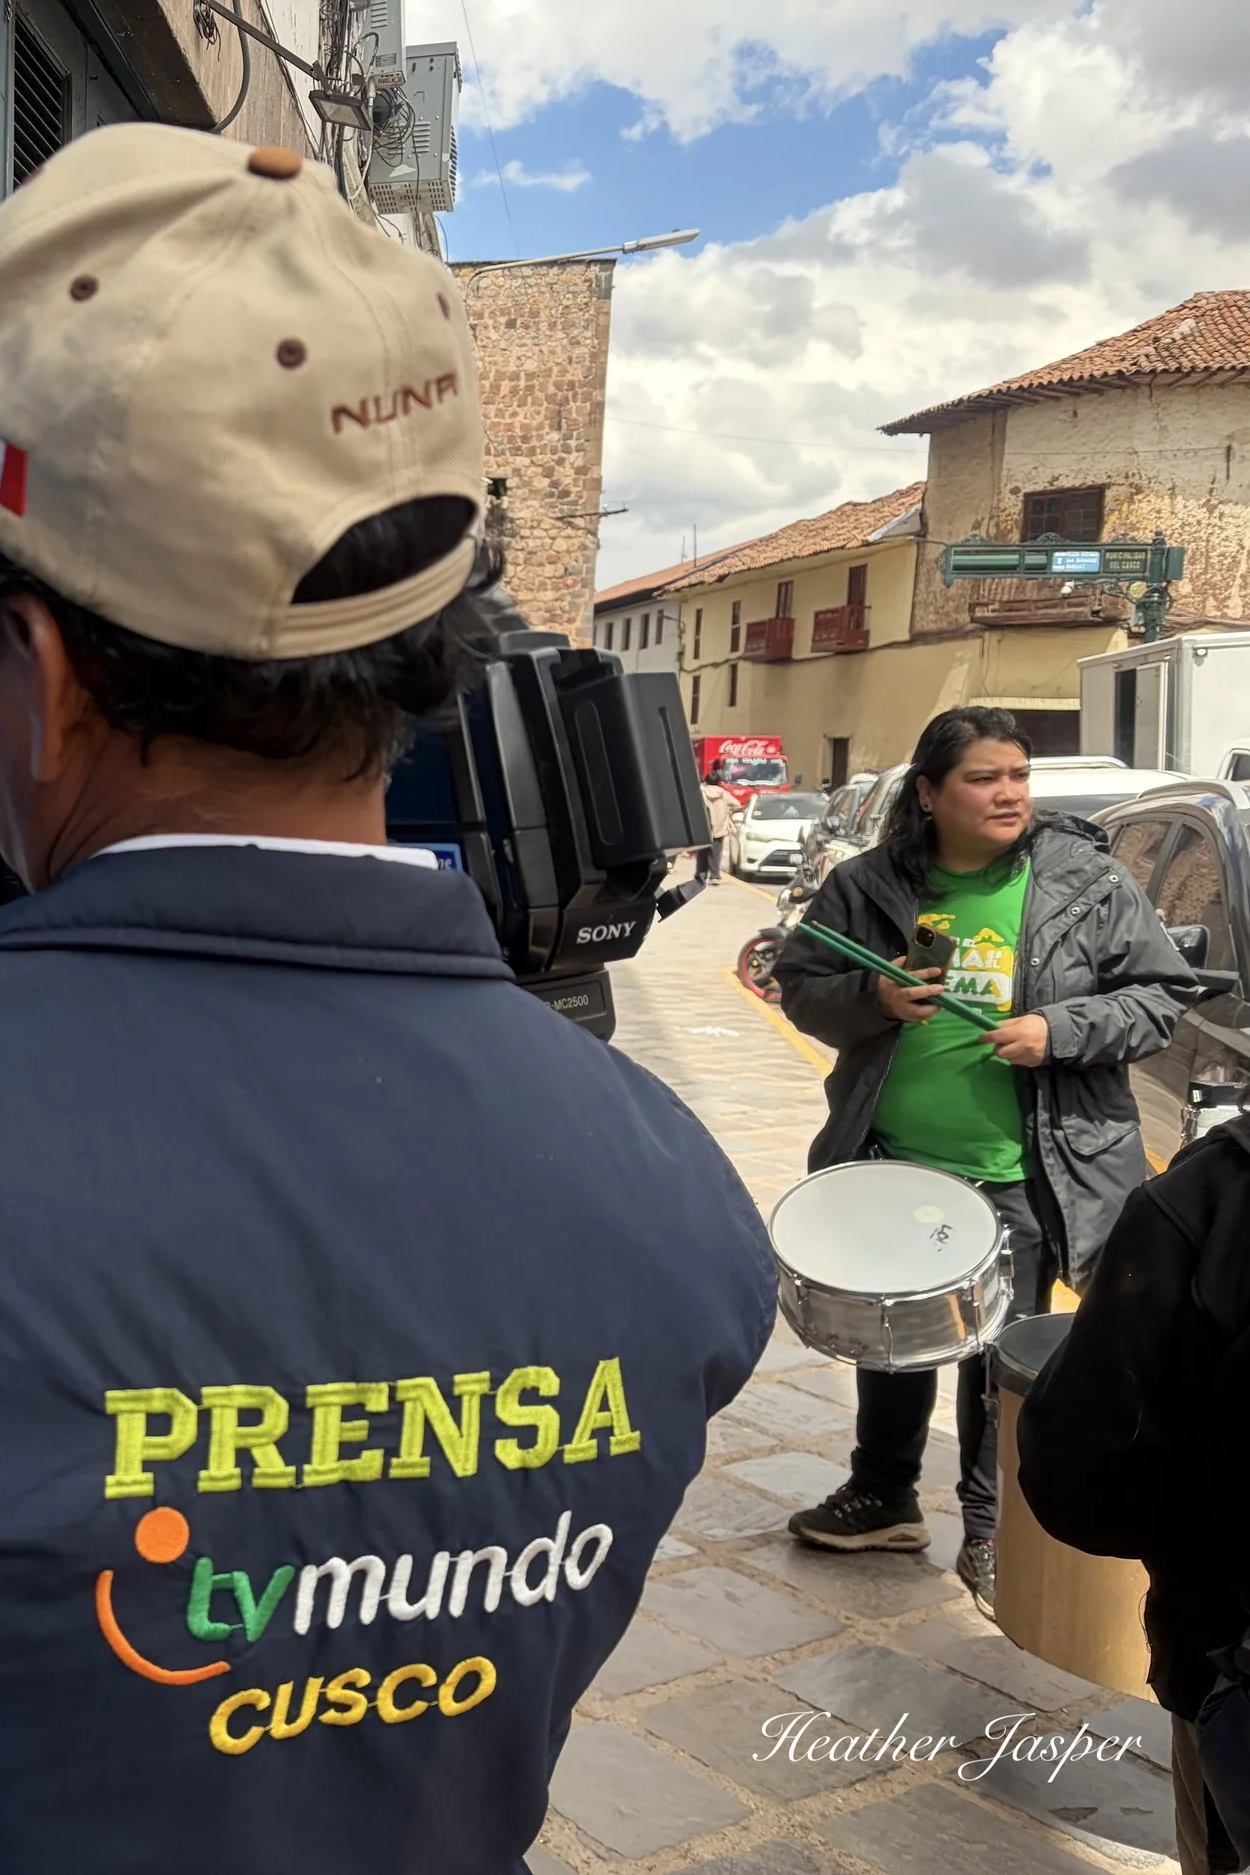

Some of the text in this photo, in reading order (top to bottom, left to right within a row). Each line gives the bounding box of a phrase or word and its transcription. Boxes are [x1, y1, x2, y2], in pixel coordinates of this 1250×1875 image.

[330, 368, 458, 435] NUNA
[576, 921, 637, 945] SONY
[104, 1357, 641, 1498] PRENSA
[208, 1656, 497, 1755] CUSCO
